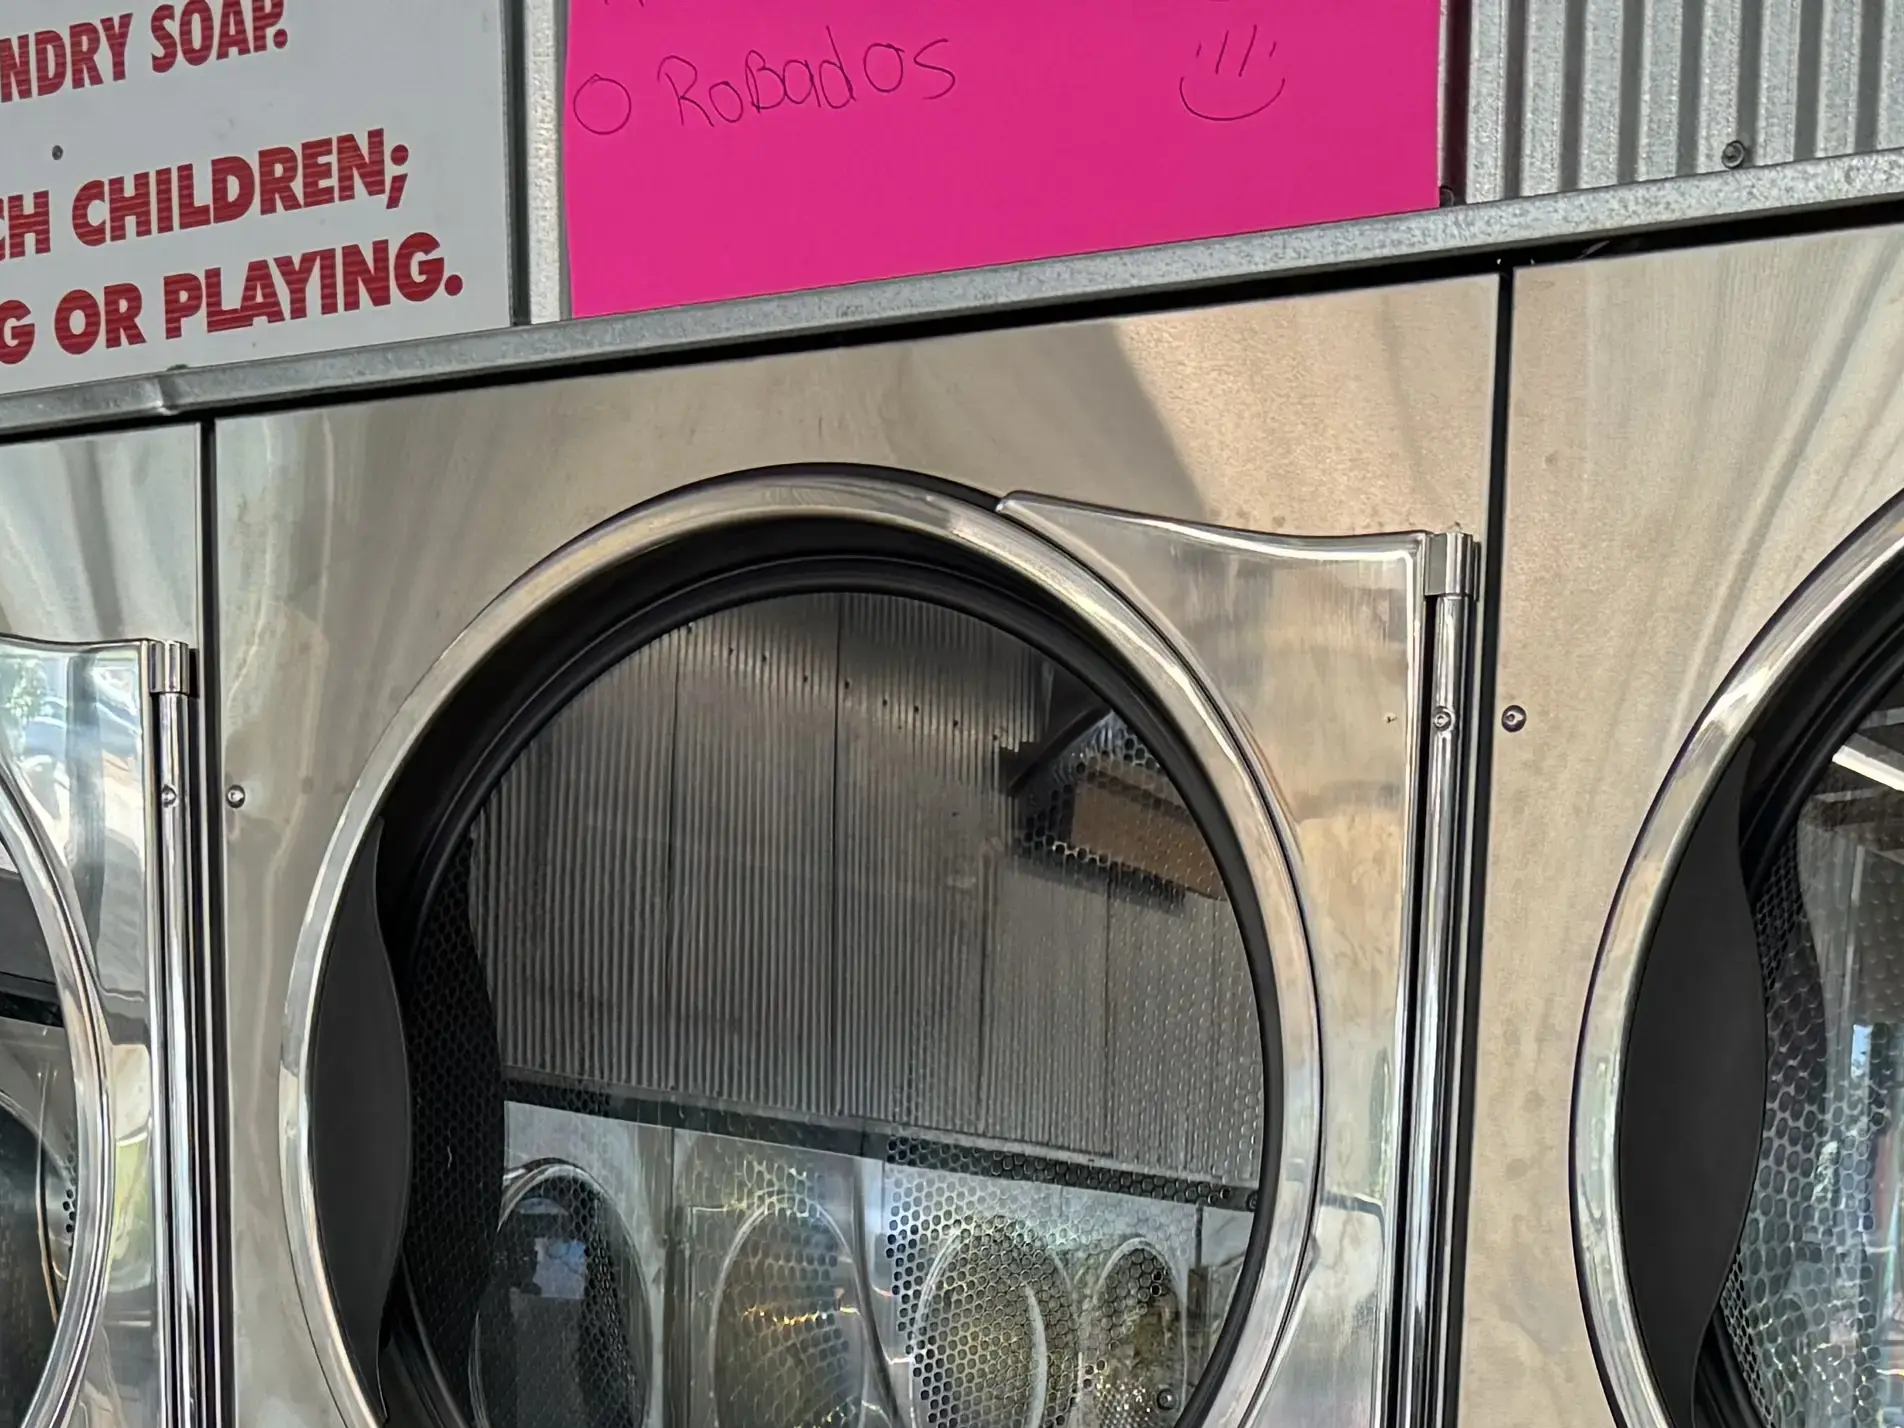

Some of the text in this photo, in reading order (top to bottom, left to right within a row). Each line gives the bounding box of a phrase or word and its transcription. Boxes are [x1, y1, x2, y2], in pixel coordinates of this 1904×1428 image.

[151, 0, 288, 73] SOAP.
[72, 127, 409, 247] CHILDREN;
[54, 282, 146, 355] OR
[163, 231, 463, 340] PLAYING.
